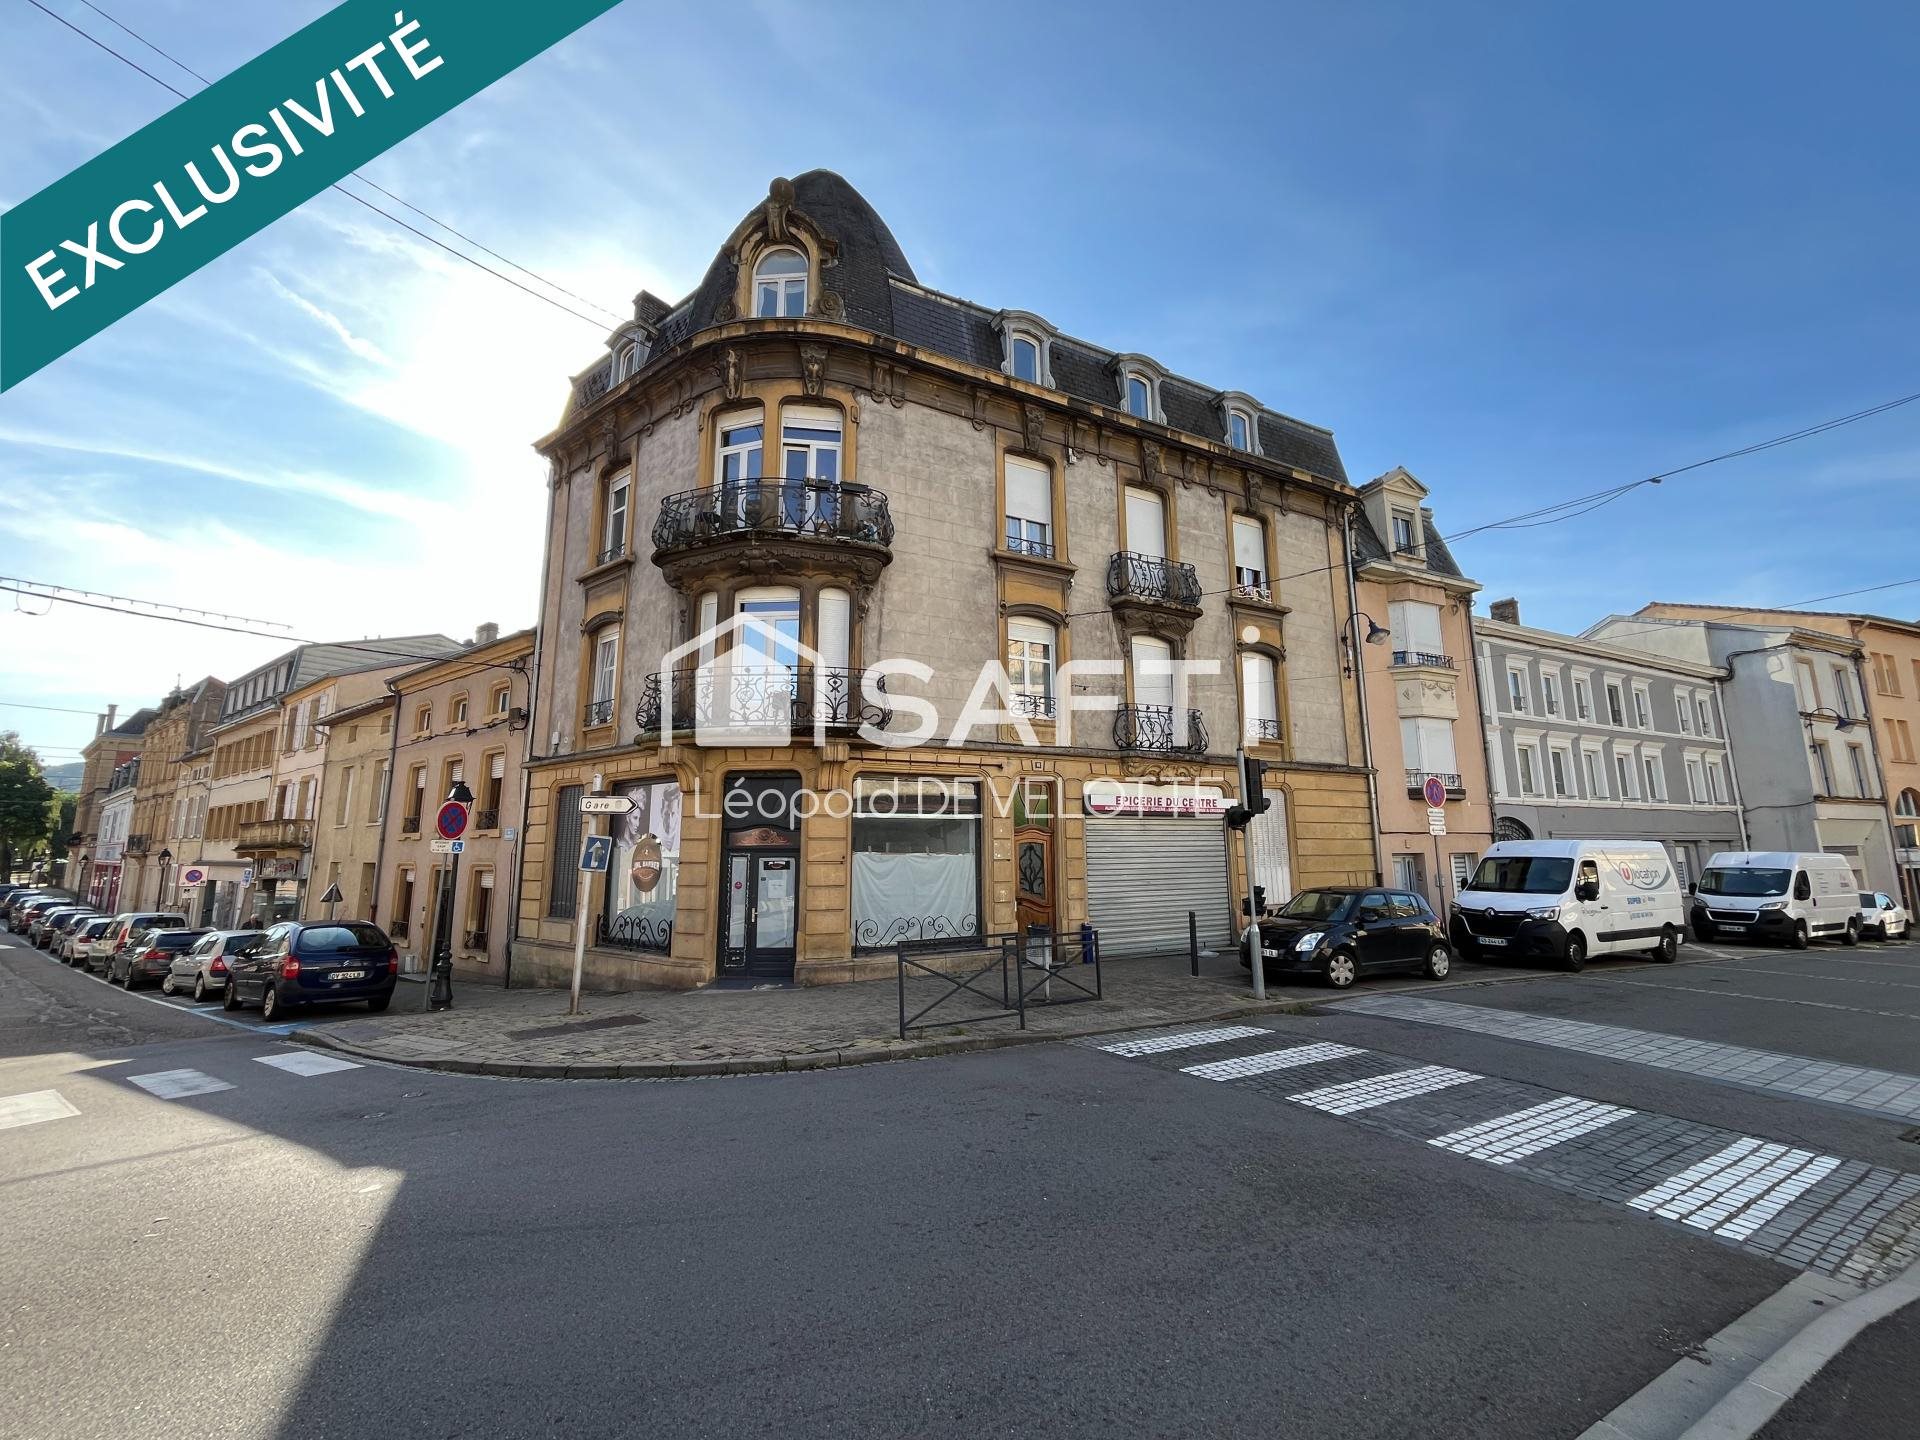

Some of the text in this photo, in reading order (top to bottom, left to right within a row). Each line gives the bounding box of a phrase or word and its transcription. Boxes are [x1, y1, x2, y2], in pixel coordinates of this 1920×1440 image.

[585, 801, 609, 810] Gare
[1115, 795, 1218, 808] EPICERIE DU CENTRE
[1632, 867, 1661, 880] location
